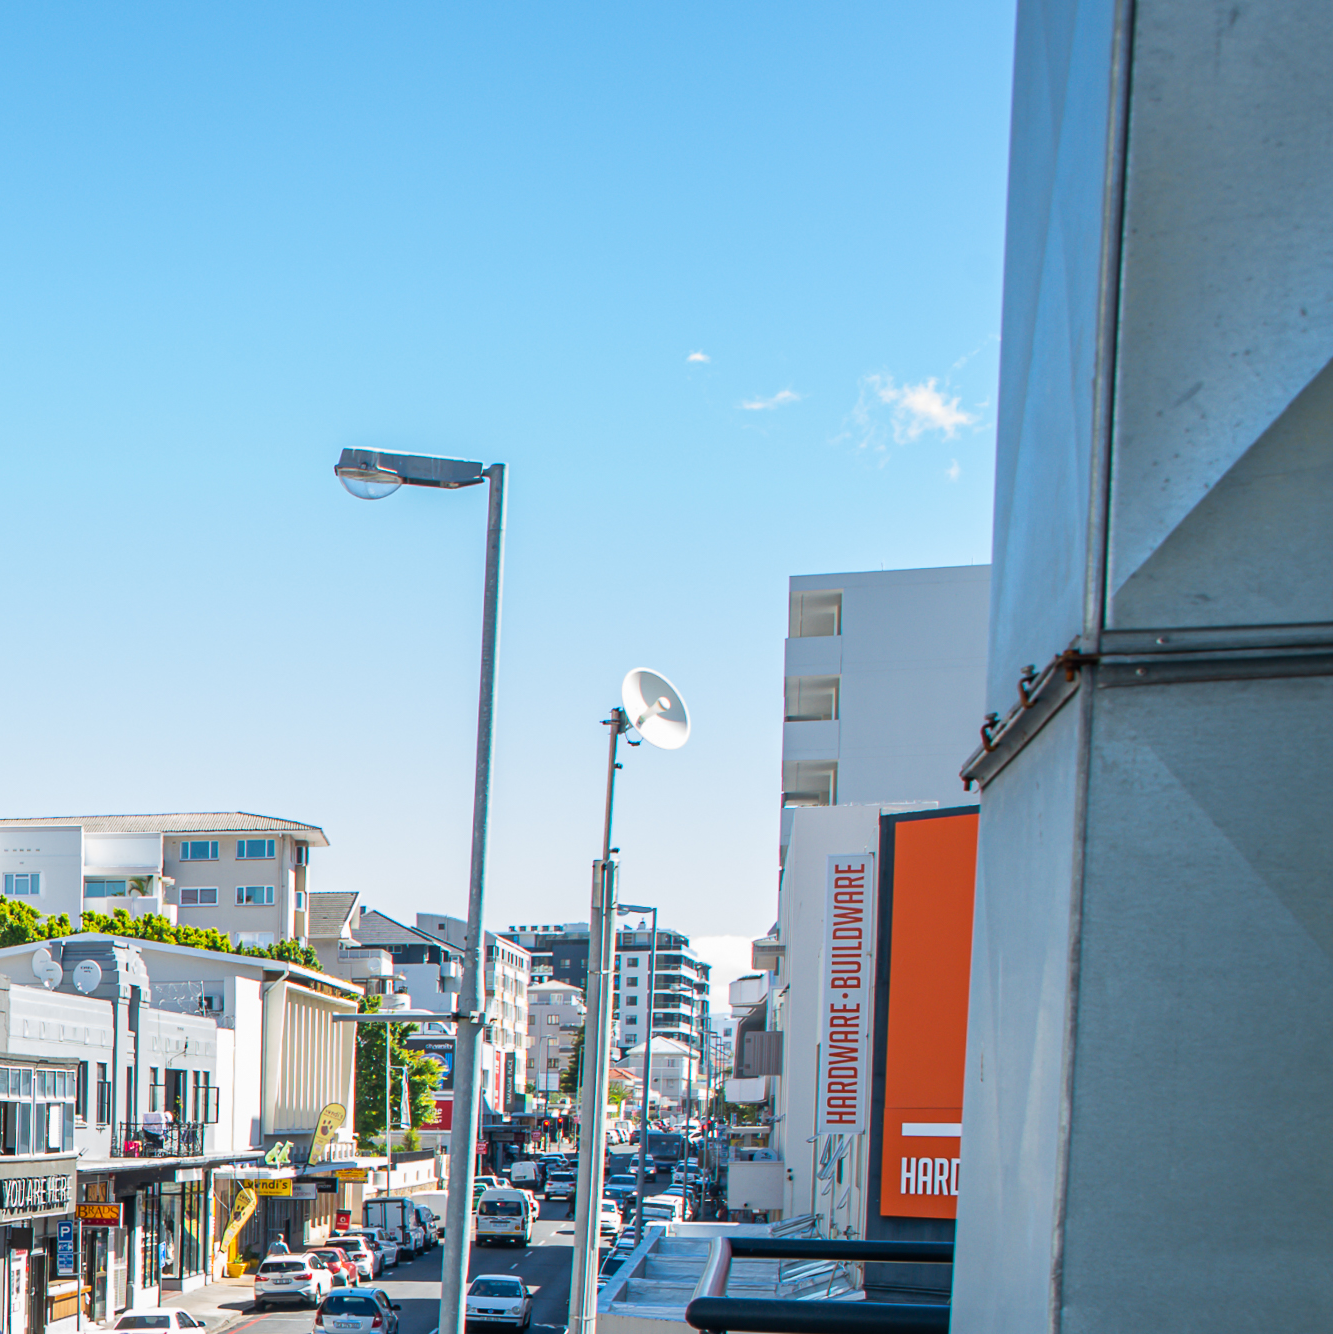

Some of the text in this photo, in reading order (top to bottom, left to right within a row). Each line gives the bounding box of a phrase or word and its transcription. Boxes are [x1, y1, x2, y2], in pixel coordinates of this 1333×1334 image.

[826, 863, 865, 1125] HARDWARE BUILDWARE
[3, 1175, 73, 1208] YOU ARE HERE
[78, 1204, 119, 1219] BRADS
[61, 1226, 70, 1237] P
